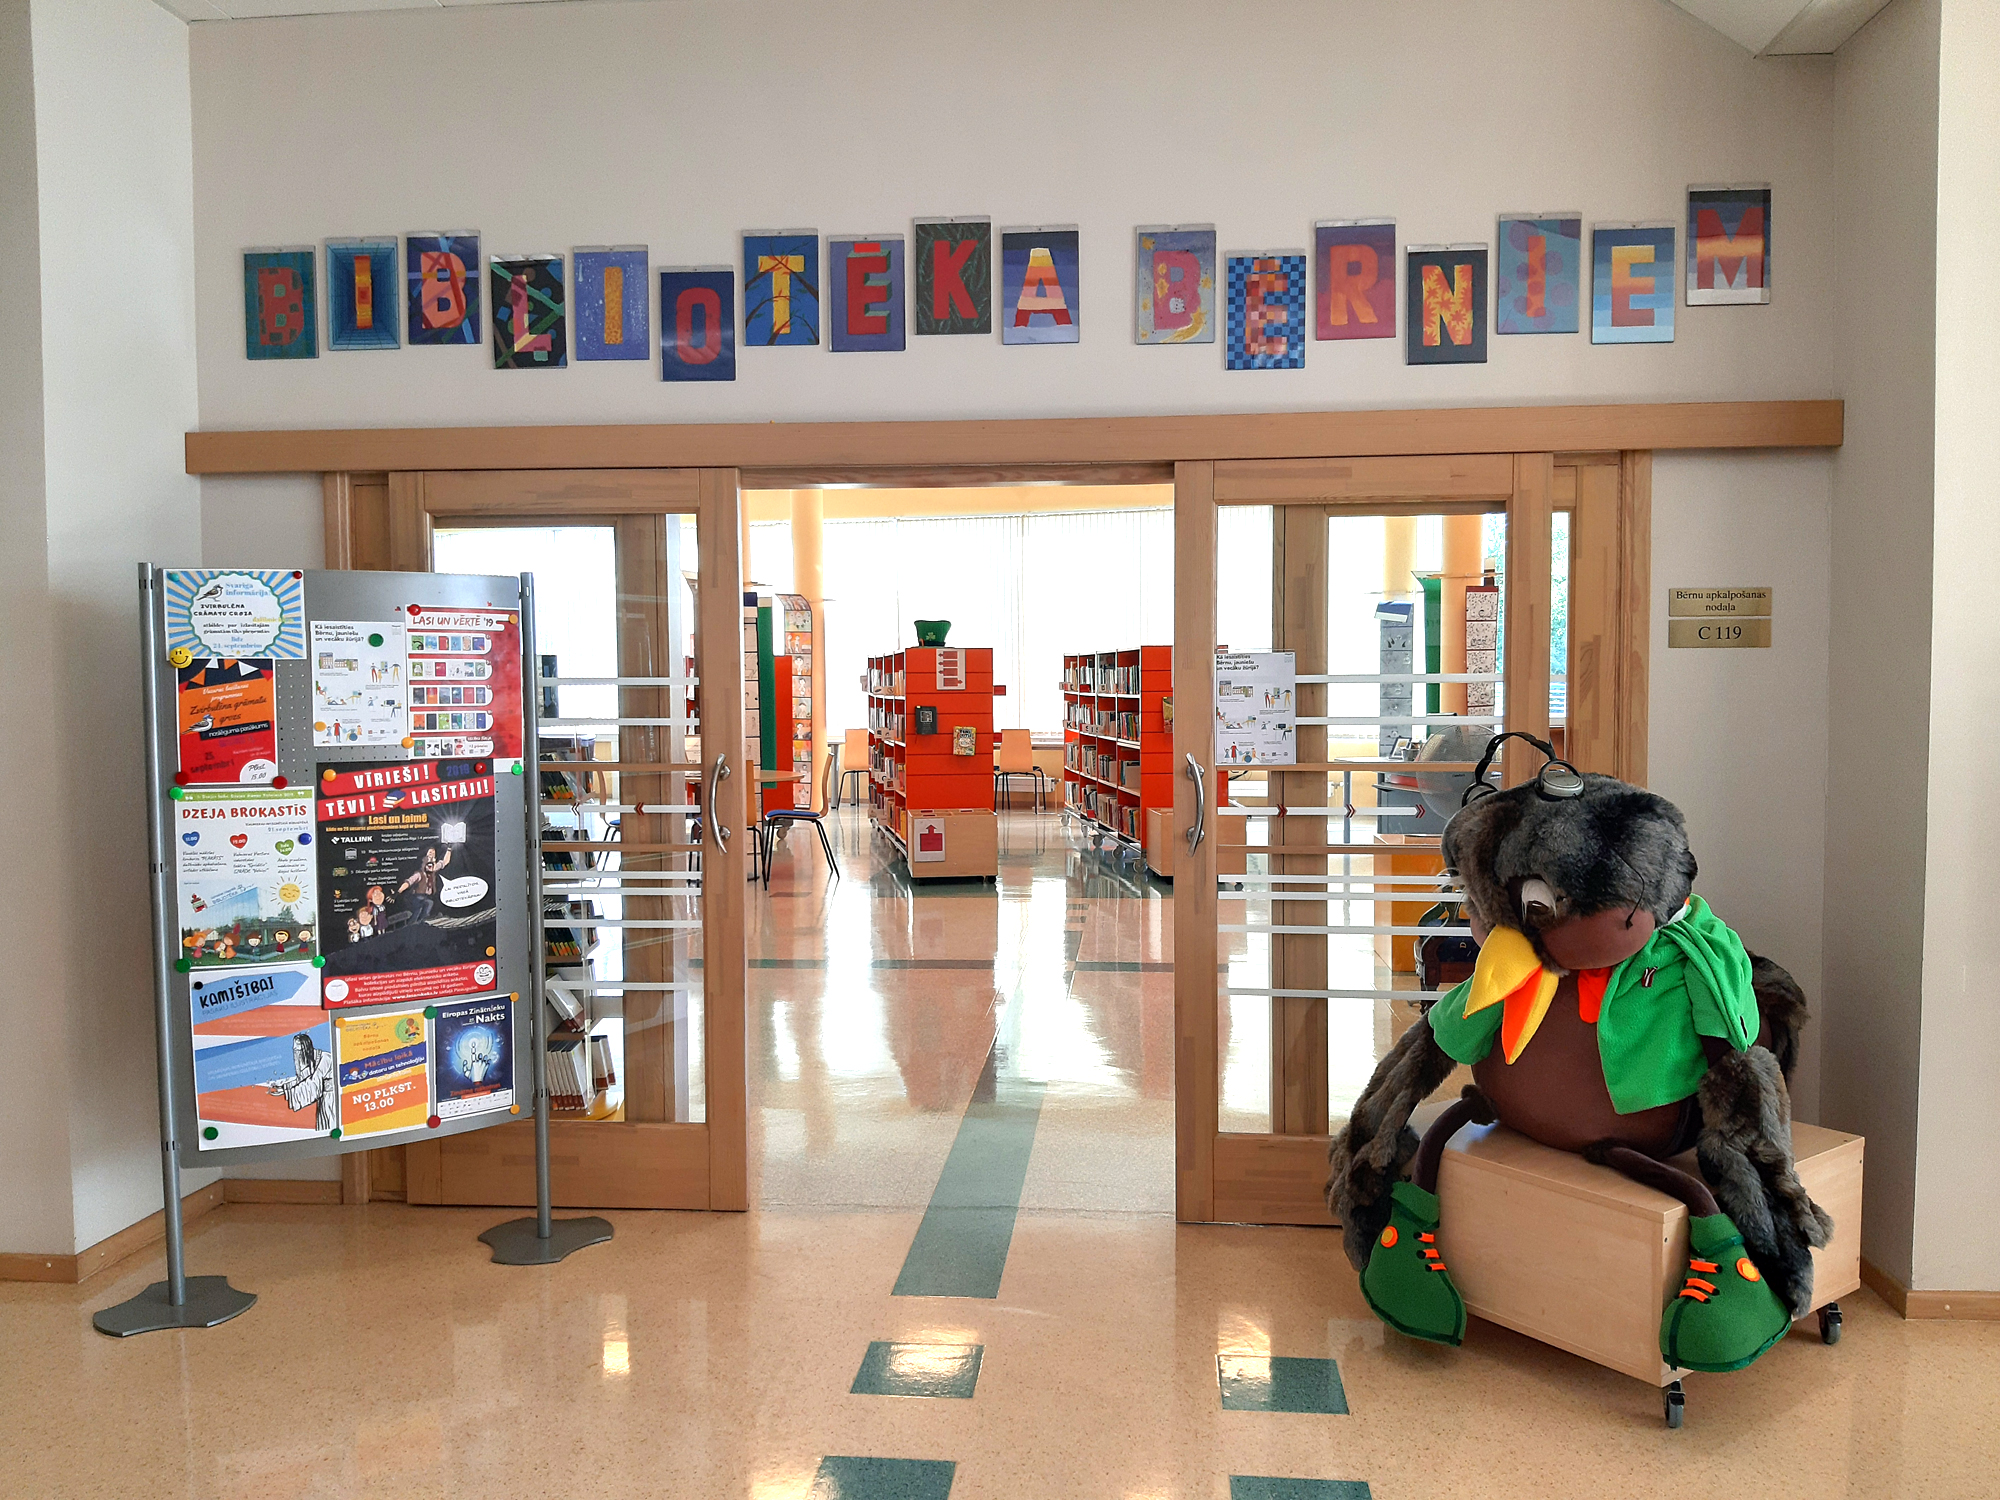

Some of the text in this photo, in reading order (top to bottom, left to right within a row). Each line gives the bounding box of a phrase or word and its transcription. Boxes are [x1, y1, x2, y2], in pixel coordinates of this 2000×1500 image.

[258, 207, 1764, 364] BIBLIOTĒKA BĒRNIEM
[1676, 590, 1767, 601] Bērnu apkalpošanas
[1705, 603, 1736, 612] nodaļa
[413, 616, 434, 625] LASI
[437, 617, 450, 625] UN
[453, 615, 481, 625] VĒRTĒ
[1698, 626, 1742, 640] C 119
[368, 815, 387, 825] Lasi
[389, 816, 400, 824] un
[442, 1010, 468, 1019] Eiropas
[476, 1013, 505, 1024] Nakts
[352, 1082, 416, 1105] NO PLKST.
[364, 1097, 394, 1112] 13.00
